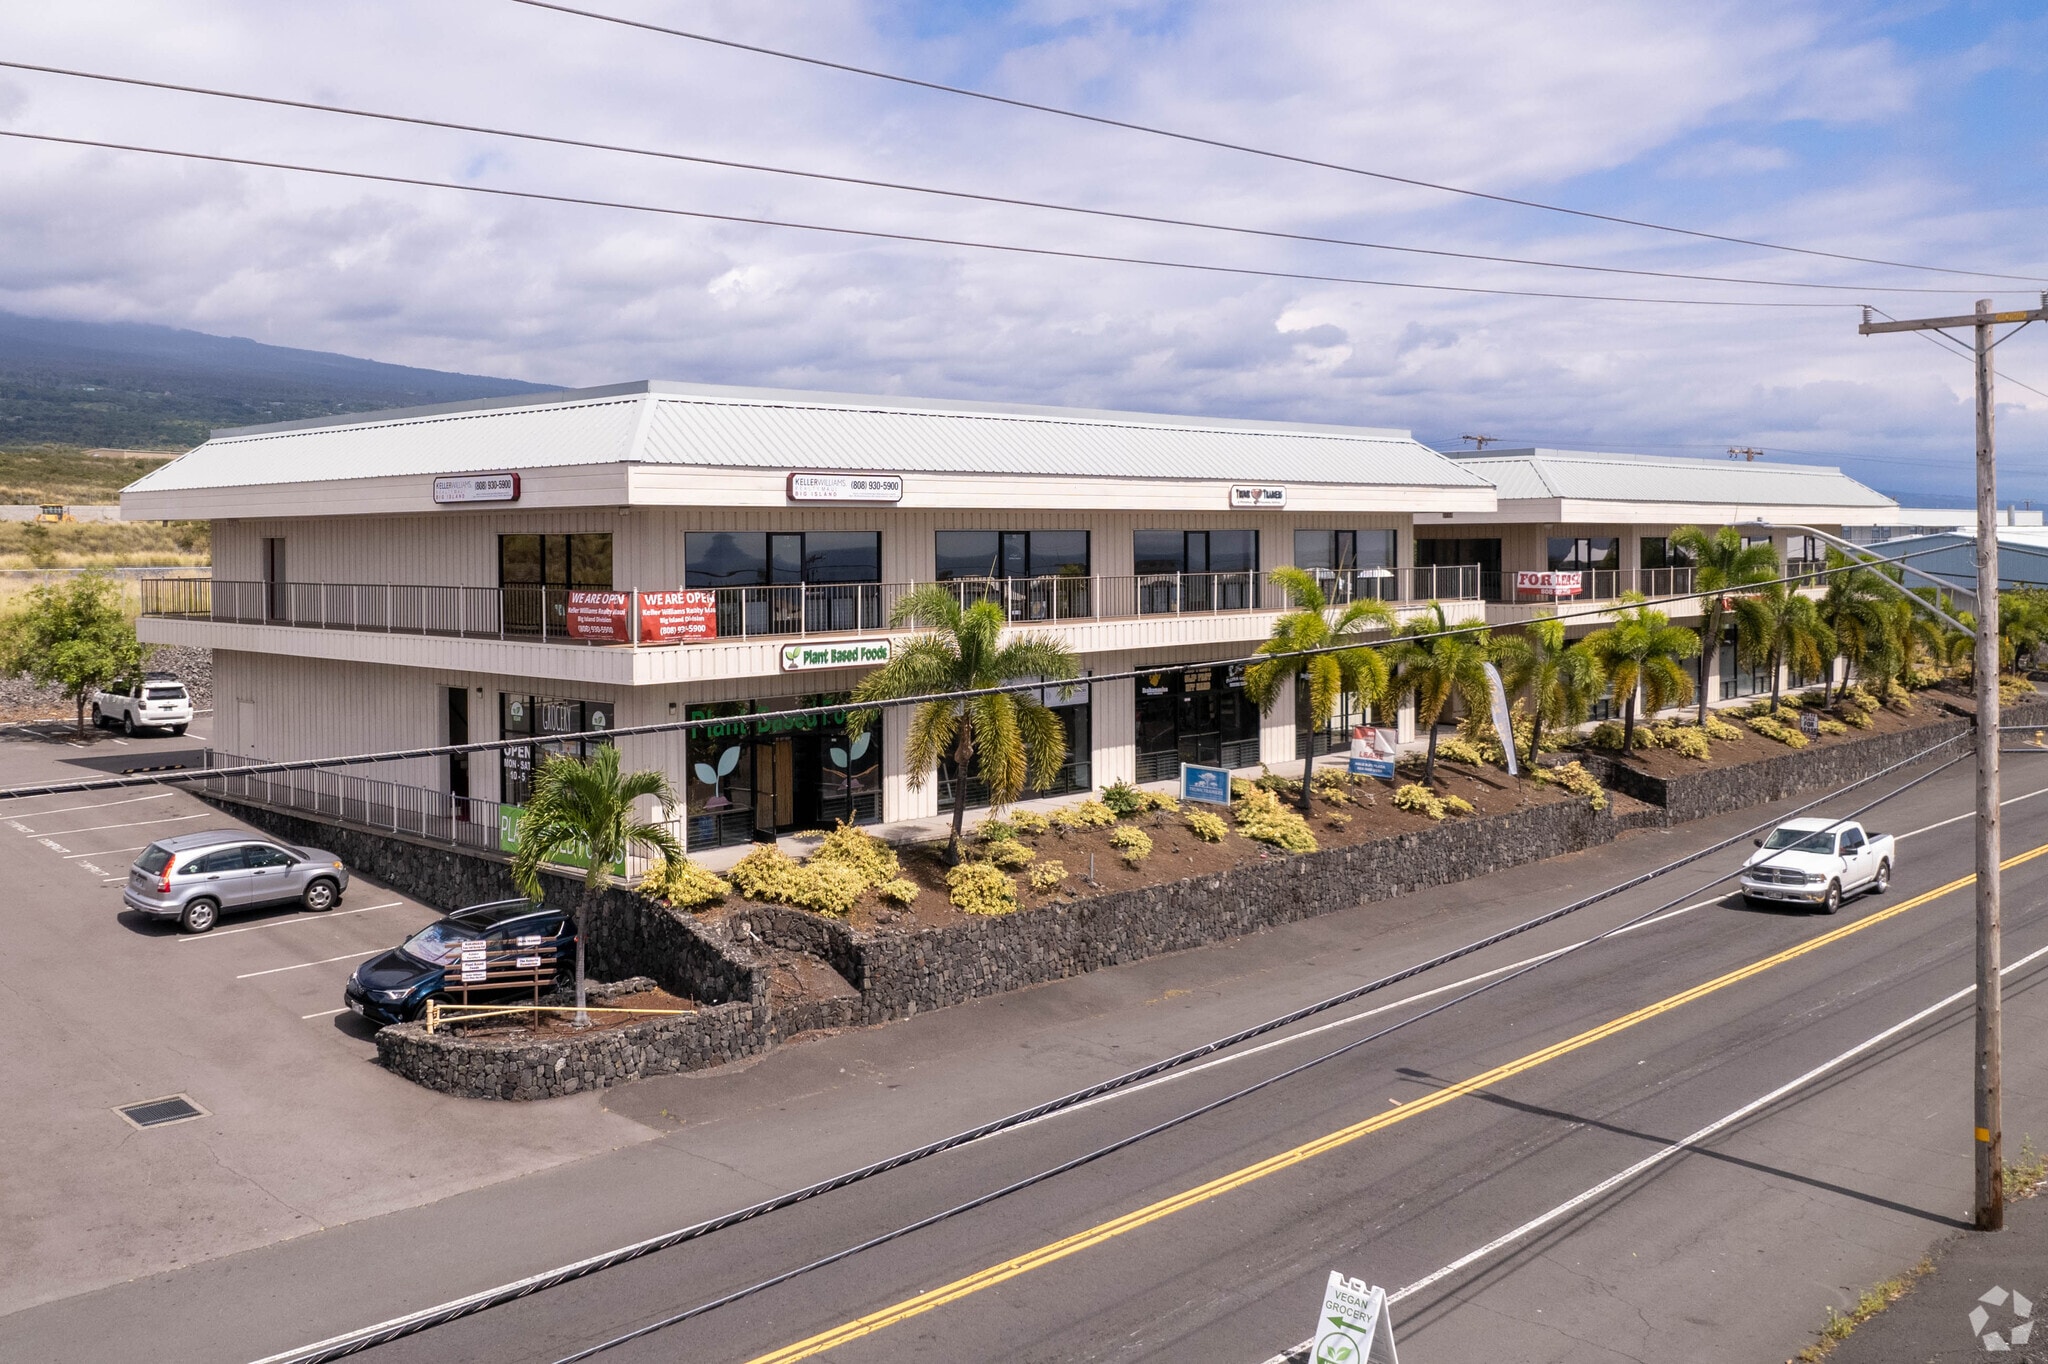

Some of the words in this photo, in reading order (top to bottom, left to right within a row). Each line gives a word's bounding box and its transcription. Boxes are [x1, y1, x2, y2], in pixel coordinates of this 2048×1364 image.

[851, 480, 867, 490] (808)
[868, 481, 899, 491] 930-5900
[1519, 573, 1552, 586] FOR
[572, 592, 585, 604] WE
[584, 593, 602, 604] ARE
[602, 593, 625, 605] OPEN
[644, 593, 663, 606] WE
[665, 592, 684, 605] ARE
[686, 591, 716, 604] OPEN
[661, 607, 686, 616] Williams
[660, 626, 677, 636] (808)
[803, 649, 829, 666] Plant
[831, 647, 859, 664] Based
[861, 645, 888, 661] Foods
[542, 704, 572, 732] GROCERY
[504, 745, 531, 759] OPEN
[504, 758, 517, 767] MON
[520, 760, 531, 770] SAT
[510, 771, 517, 781] 10
[1335, 1290, 1369, 1309] VEGAN
[1325, 1300, 1373, 1324] GROCERY
